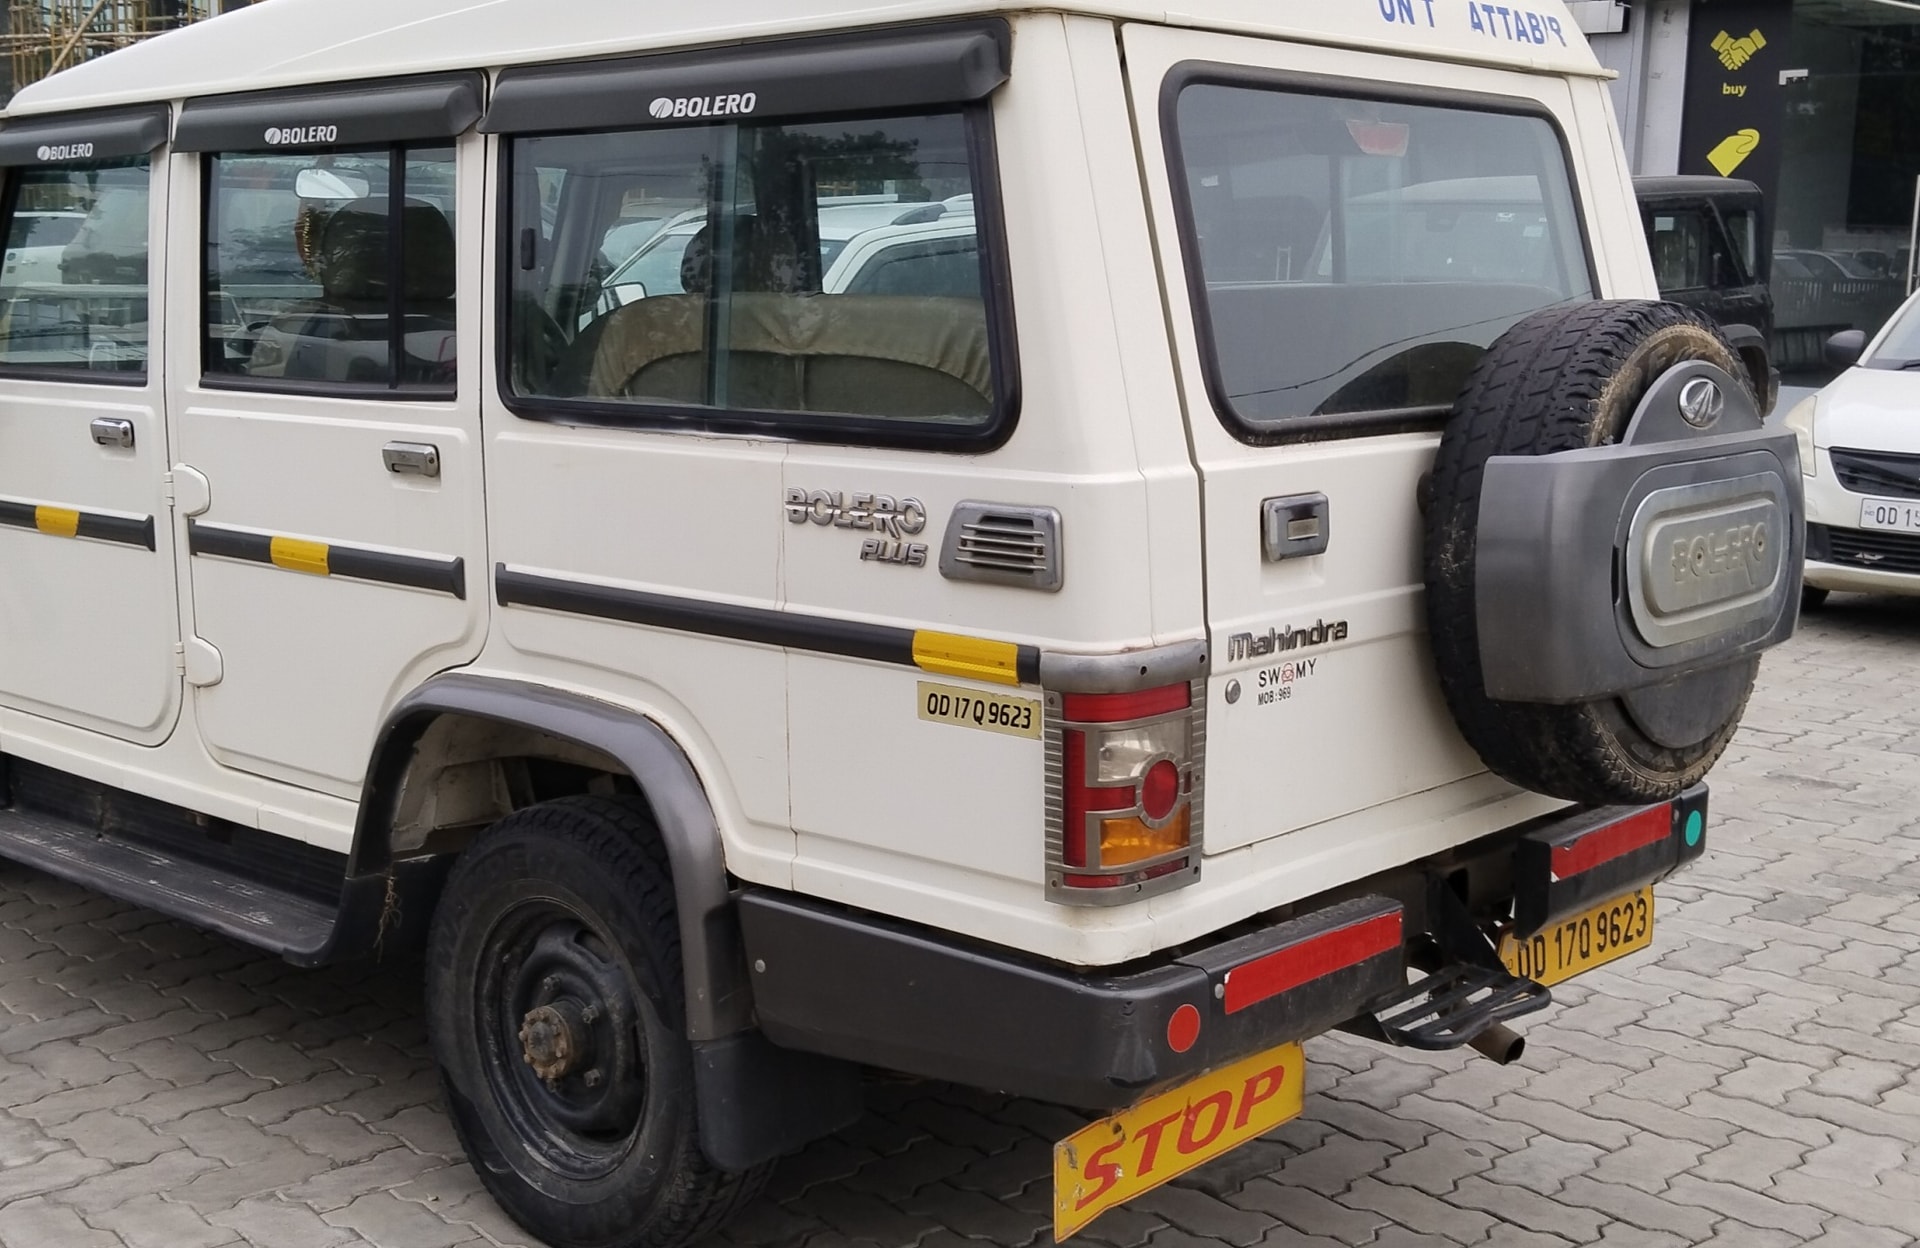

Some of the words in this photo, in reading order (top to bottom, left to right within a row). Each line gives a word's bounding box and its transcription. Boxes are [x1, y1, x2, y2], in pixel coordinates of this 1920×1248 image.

[1722, 82, 1747, 97] buy
[672, 92, 756, 118] BOLERO
[281, 125, 337, 145] BOLERO
[50, 142, 93, 161] BOLERO
[785, 487, 927, 539] BOLERO
[1876, 506, 1898, 525] OD
[859, 538, 929, 568] PLUS
[1671, 521, 1768, 586] BOLERO
[1228, 618, 1348, 662] Mahindra
[988, 702, 1031, 729] 9623
[1597, 898, 1647, 953] 9623
[1075, 1065, 1285, 1211] STOP
